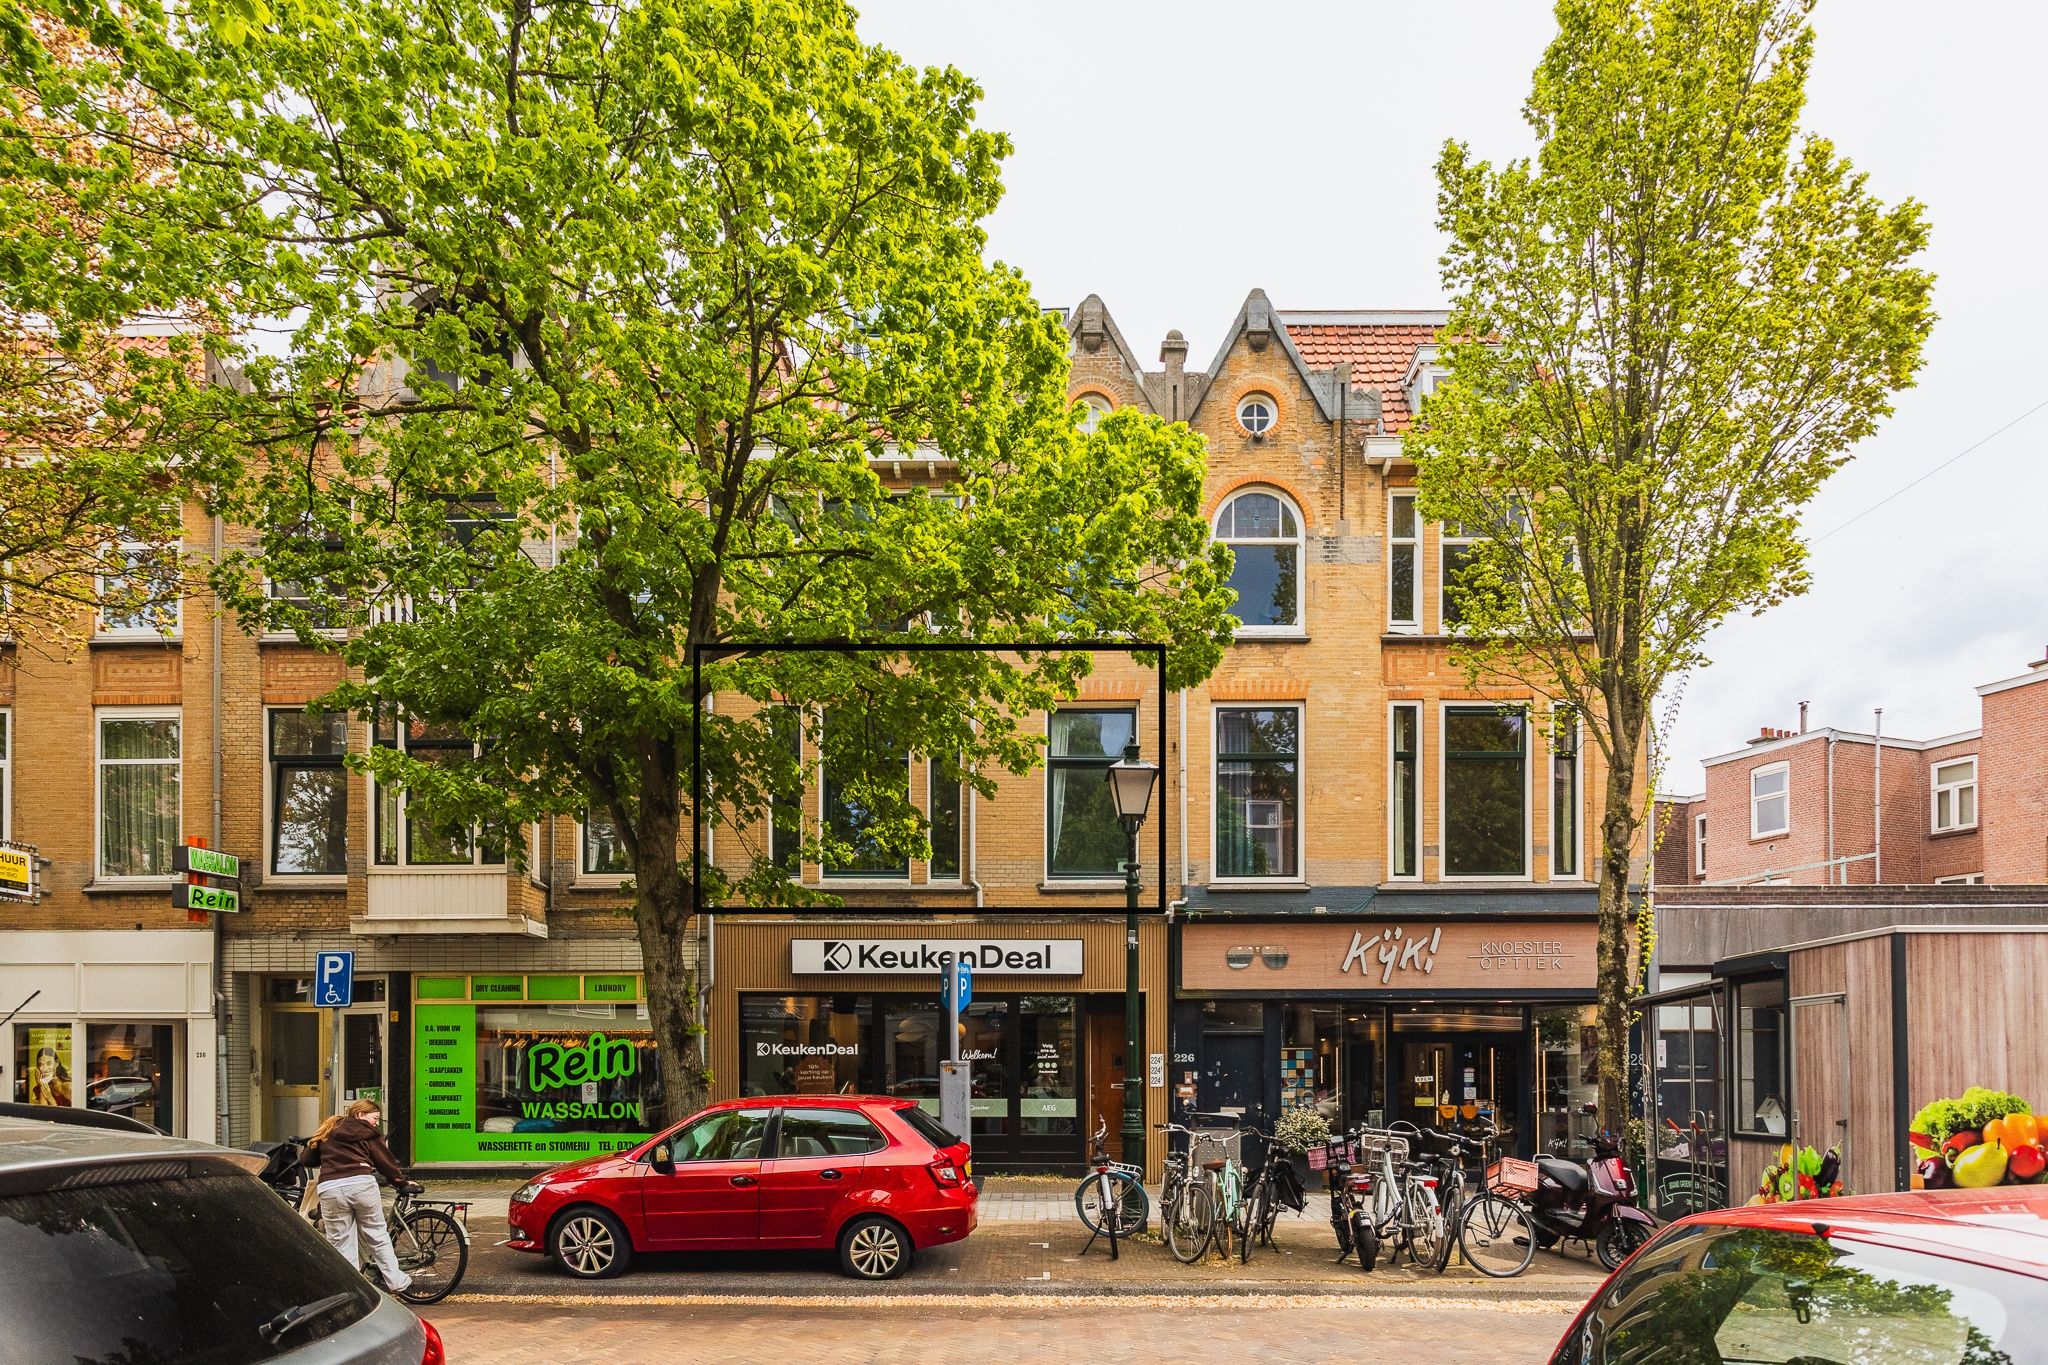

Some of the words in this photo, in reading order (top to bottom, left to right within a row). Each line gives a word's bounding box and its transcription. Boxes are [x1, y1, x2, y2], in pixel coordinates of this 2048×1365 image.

[191, 849, 238, 877] WASSALON
[191, 888, 236, 909] Rein
[1480, 941, 1562, 954] KNOESTER
[858, 944, 1051, 969] KeukenDeal
[1480, 957, 1562, 970] OPTIEK
[324, 956, 344, 984] P
[944, 978, 948, 998] P
[960, 978, 967, 998] P
[772, 1043, 858, 1055] KeukenDeal
[962, 1048, 998, 1060] Welkom!
[530, 1034, 634, 1091] Rein
[1174, 1054, 1194, 1062] 226
[1630, 1054, 1643, 1066] 28
[522, 1102, 640, 1118] WASSALON
[478, 1142, 532, 1151] WASSERETTE
[536, 1142, 546, 1151] en
[550, 1142, 590, 1151] STOMERIJ
[598, 1142, 614, 1151] TEL:
